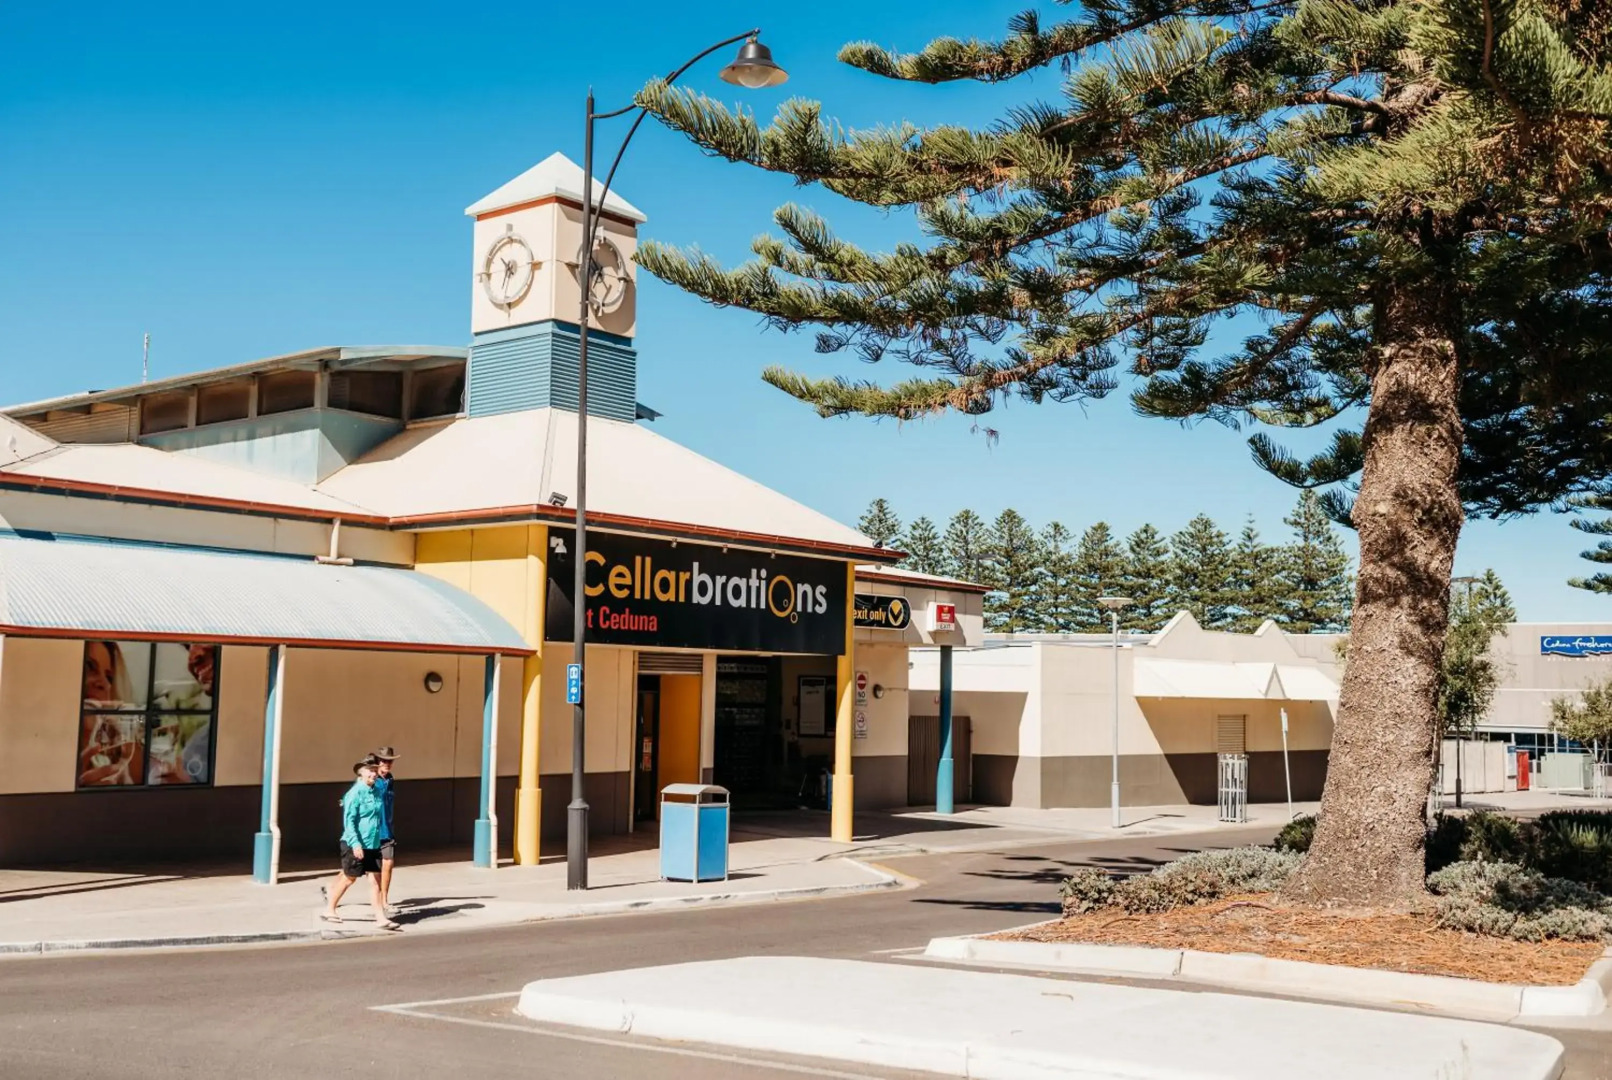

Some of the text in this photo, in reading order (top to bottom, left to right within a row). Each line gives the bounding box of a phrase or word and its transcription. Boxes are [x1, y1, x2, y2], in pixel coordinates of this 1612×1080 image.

[584, 551, 827, 617] Cellarbrations
[585, 606, 658, 632] t Ceduna
[853, 606, 886, 624] exit only
